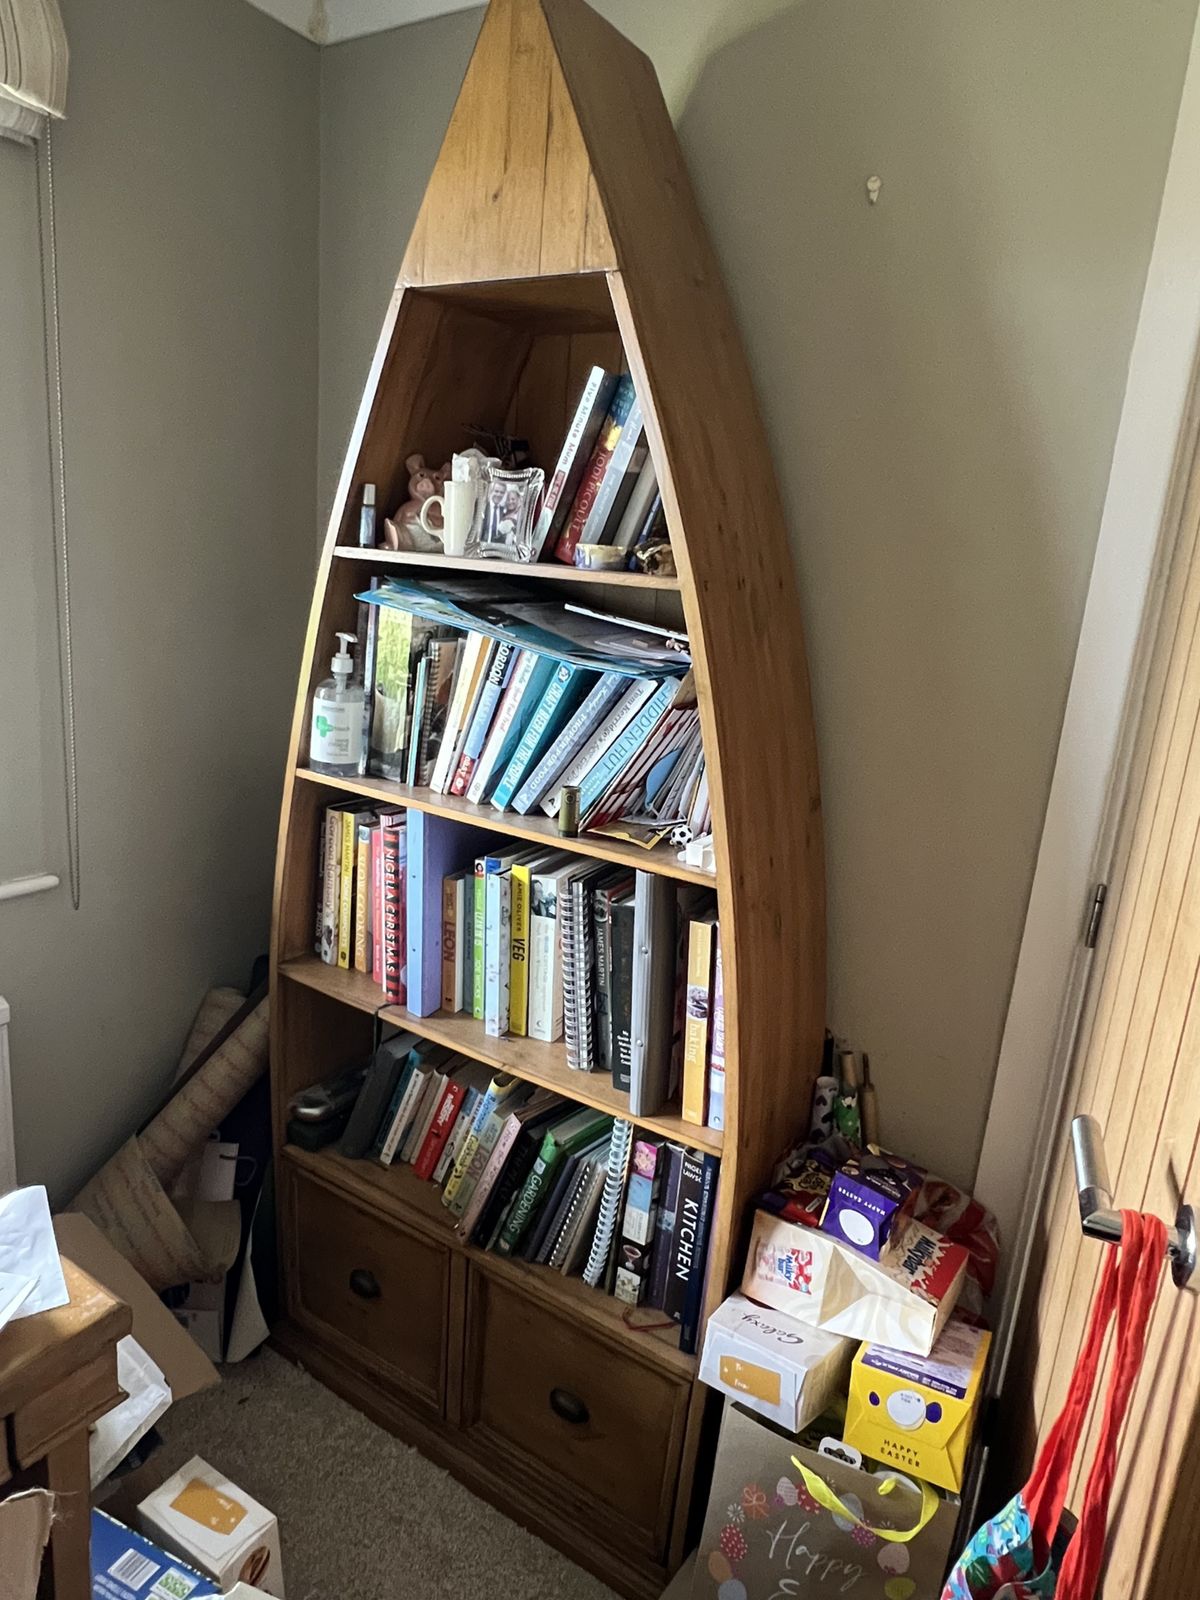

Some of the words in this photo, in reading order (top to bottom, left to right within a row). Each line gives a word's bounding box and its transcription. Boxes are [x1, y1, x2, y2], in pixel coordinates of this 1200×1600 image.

[571, 404, 588, 439] Minute
[561, 441, 575, 466] Mum
[589, 450, 608, 480] JODI
[569, 479, 597, 532] PICOULT
[541, 681, 564, 711] CRAFT
[626, 686, 644, 706] Tom
[530, 708, 551, 732] BEER
[558, 712, 587, 749] PROPER
[596, 704, 630, 744] Kerridge's
[623, 690, 670, 745] HIDDEN
[514, 743, 532, 763] THE
[522, 727, 540, 748] FOR
[547, 747, 562, 764] PUB
[598, 742, 629, 775] HUT
[500, 759, 525, 790] PEOPLE
[528, 762, 551, 790] FOOD
[328, 816, 337, 862] Gordon
[358, 854, 367, 888] SLOW
[384, 849, 395, 899] NIGELLA
[356, 893, 367, 956] COOKING
[384, 904, 395, 972] CHRISTMAS
[443, 921, 455, 962] LEON
[512, 939, 525, 961] VEG
[687, 1023, 701, 1062] baking
[464, 1143, 490, 1181] LEON
[508, 1173, 543, 1233] GARDENING
[837, 1186, 862, 1204] EASTER
[862, 1201, 886, 1216] HAPPY
[674, 1197, 699, 1280] KITCHEN
[778, 1257, 786, 1273] bar
[785, 1254, 793, 1281] Milky
[902, 1235, 937, 1276] Milkybar
[741, 1312, 805, 1345] Galaxy
[880, 1446, 921, 1468] EASTER
[883, 1439, 919, 1456] HAPPY
[766, 1520, 865, 1592] Happy
